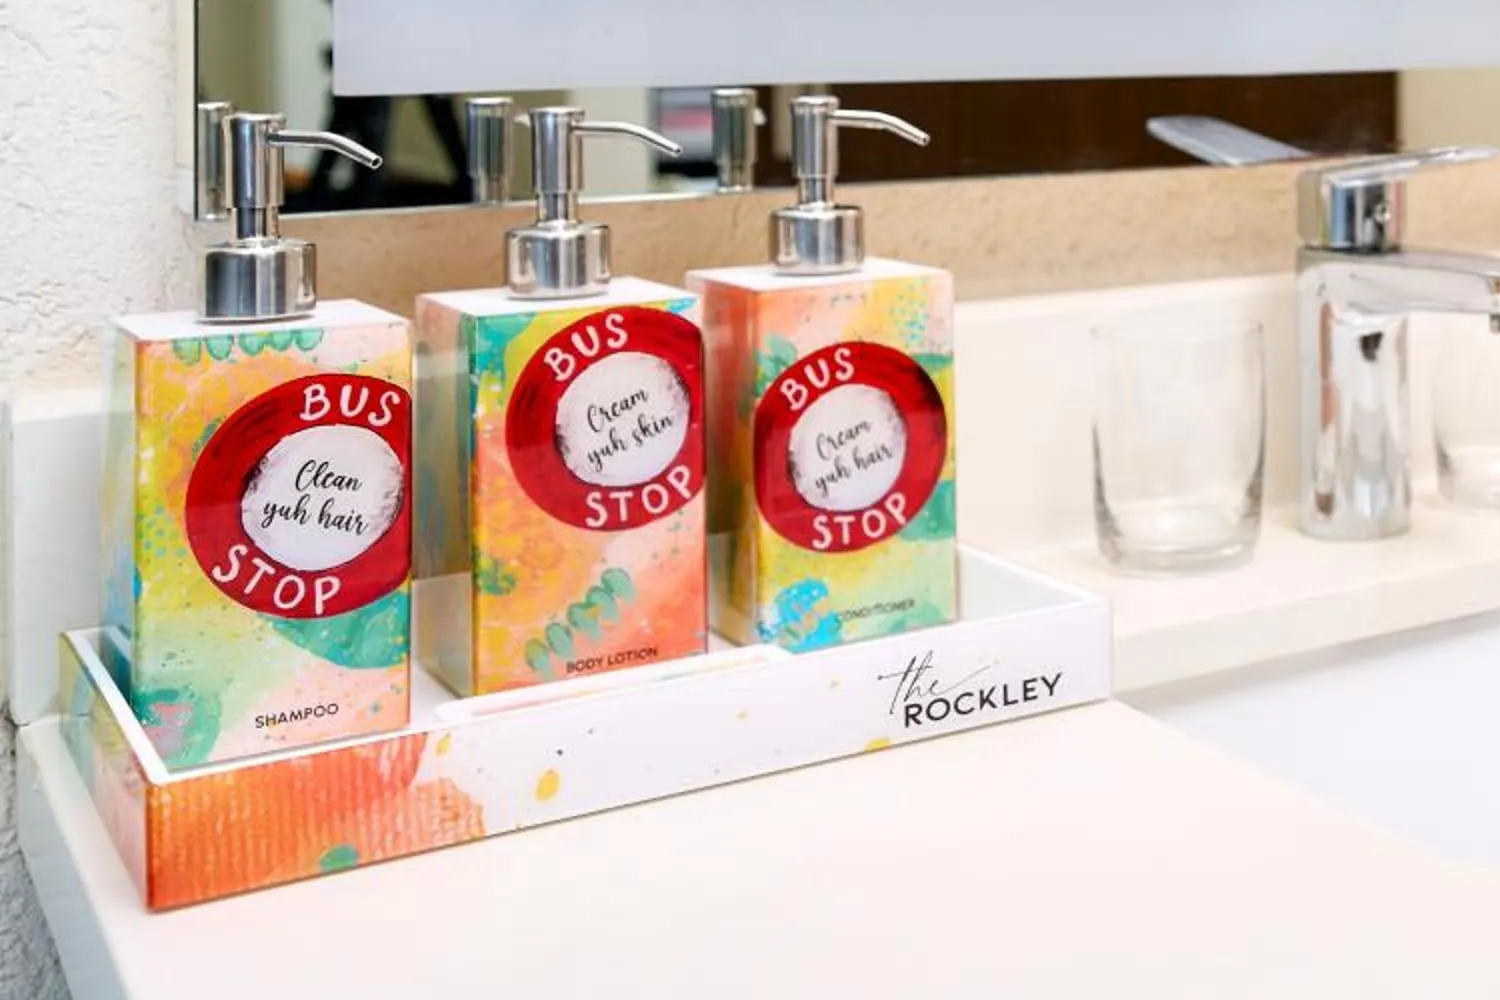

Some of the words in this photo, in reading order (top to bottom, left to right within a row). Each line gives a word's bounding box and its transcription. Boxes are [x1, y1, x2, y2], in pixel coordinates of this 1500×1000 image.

[544, 313, 629, 382] BUS
[780, 347, 855, 410] BUS
[300, 382, 400, 426] BUS
[587, 389, 648, 433] Cream
[587, 431, 628, 471] yuh
[632, 413, 674, 446] skin
[816, 420, 872, 461] Cream
[295, 460, 362, 492] Clean
[815, 459, 851, 493] yuh
[854, 445, 894, 472] hair
[263, 497, 310, 528] yuh
[318, 500, 369, 535] hair
[585, 465, 692, 528] STOP
[812, 492, 908, 549] STOP
[212, 544, 341, 615] STOP
[835, 598, 915, 623] CONDITIONER
[566, 656, 603, 674] BODY
[607, 646, 658, 668] LOTION
[255, 702, 339, 729] SHAMPOO
[904, 672, 1062, 729] ROCKLEY
